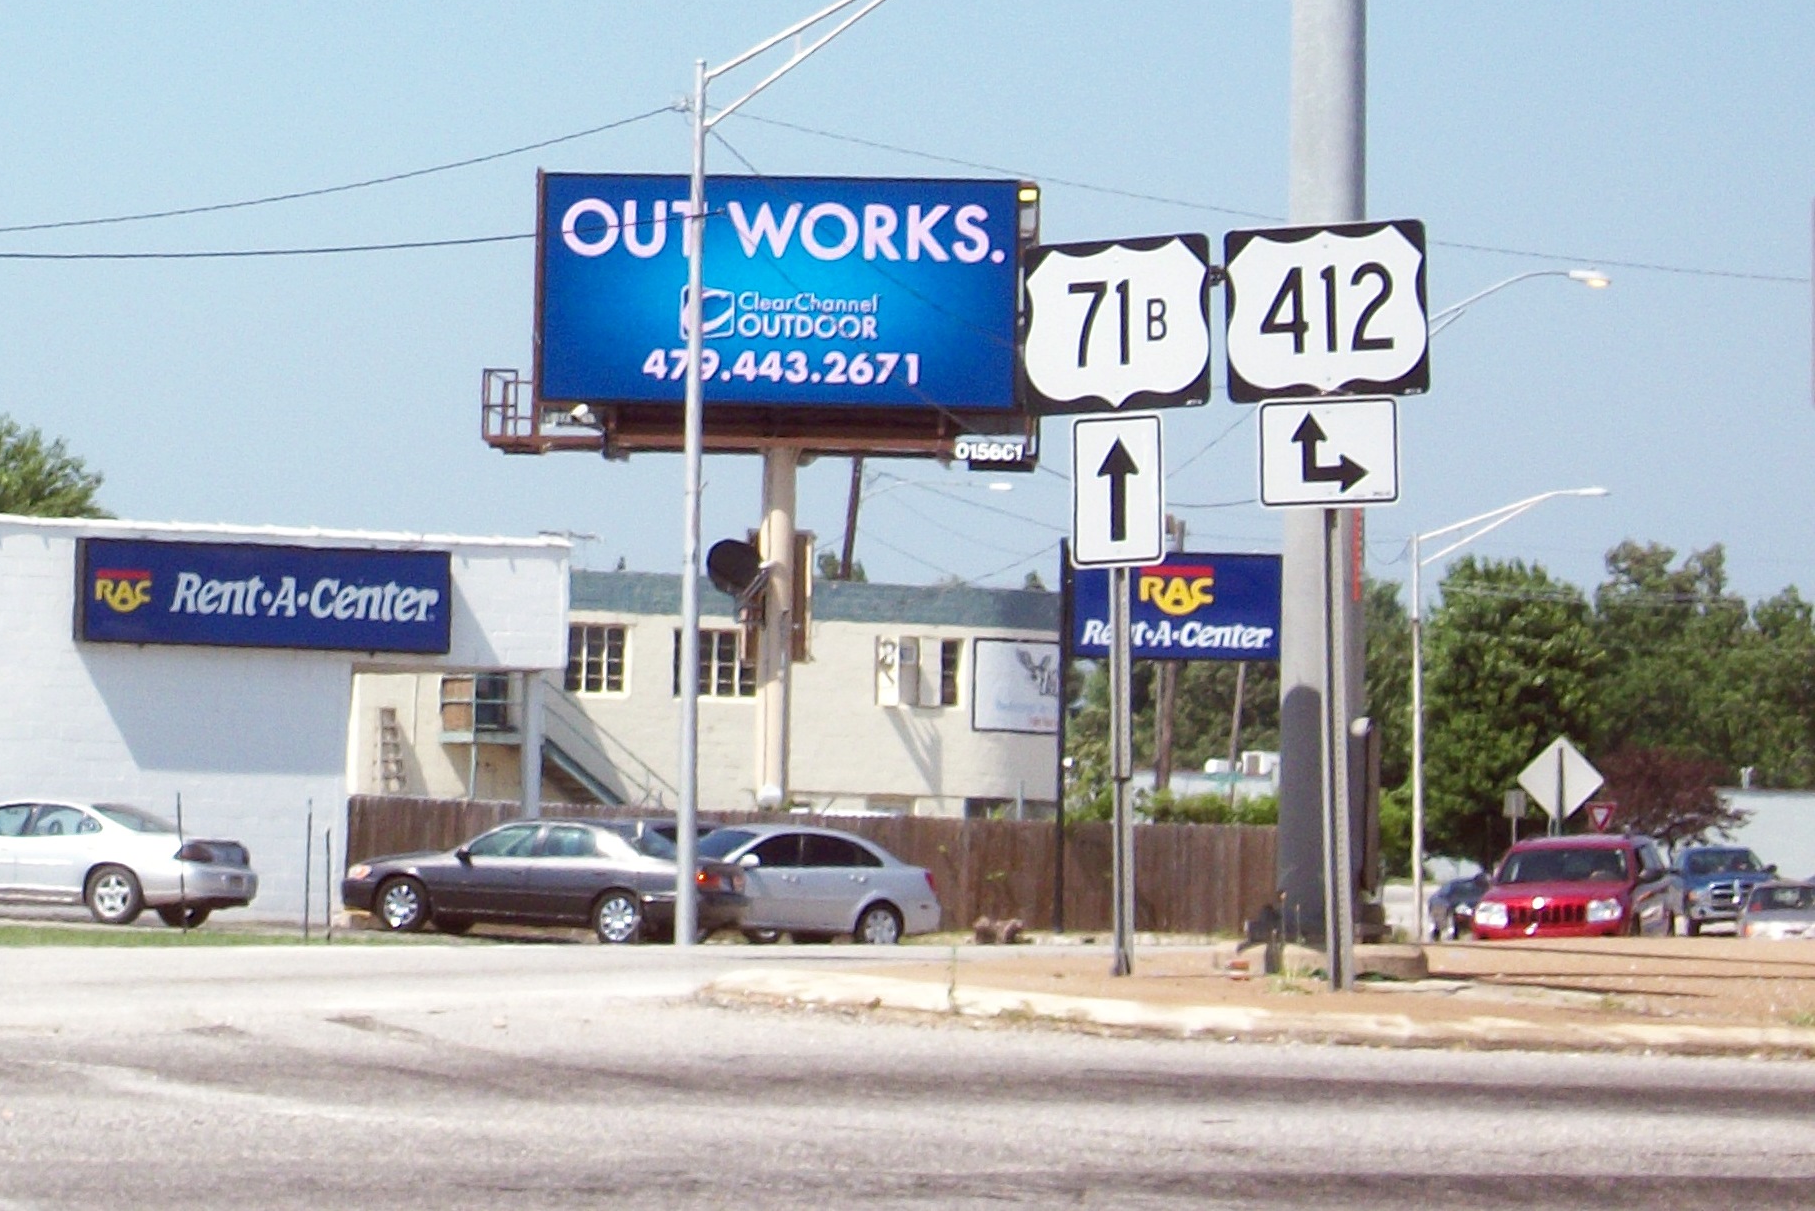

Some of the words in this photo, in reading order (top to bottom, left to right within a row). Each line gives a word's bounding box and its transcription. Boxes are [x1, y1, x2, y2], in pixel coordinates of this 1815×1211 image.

[561, 198, 709, 258] OUT
[726, 201, 1007, 264] WORKS.
[737, 314, 879, 339] OUTDOOR
[1067, 278, 1131, 368] 71
[1146, 298, 1168, 341] B
[1260, 262, 1396, 355] 412
[641, 348, 921, 386] 479.443.2671
[94, 579, 151, 613] RAC
[1139, 576, 1215, 616] RAC
